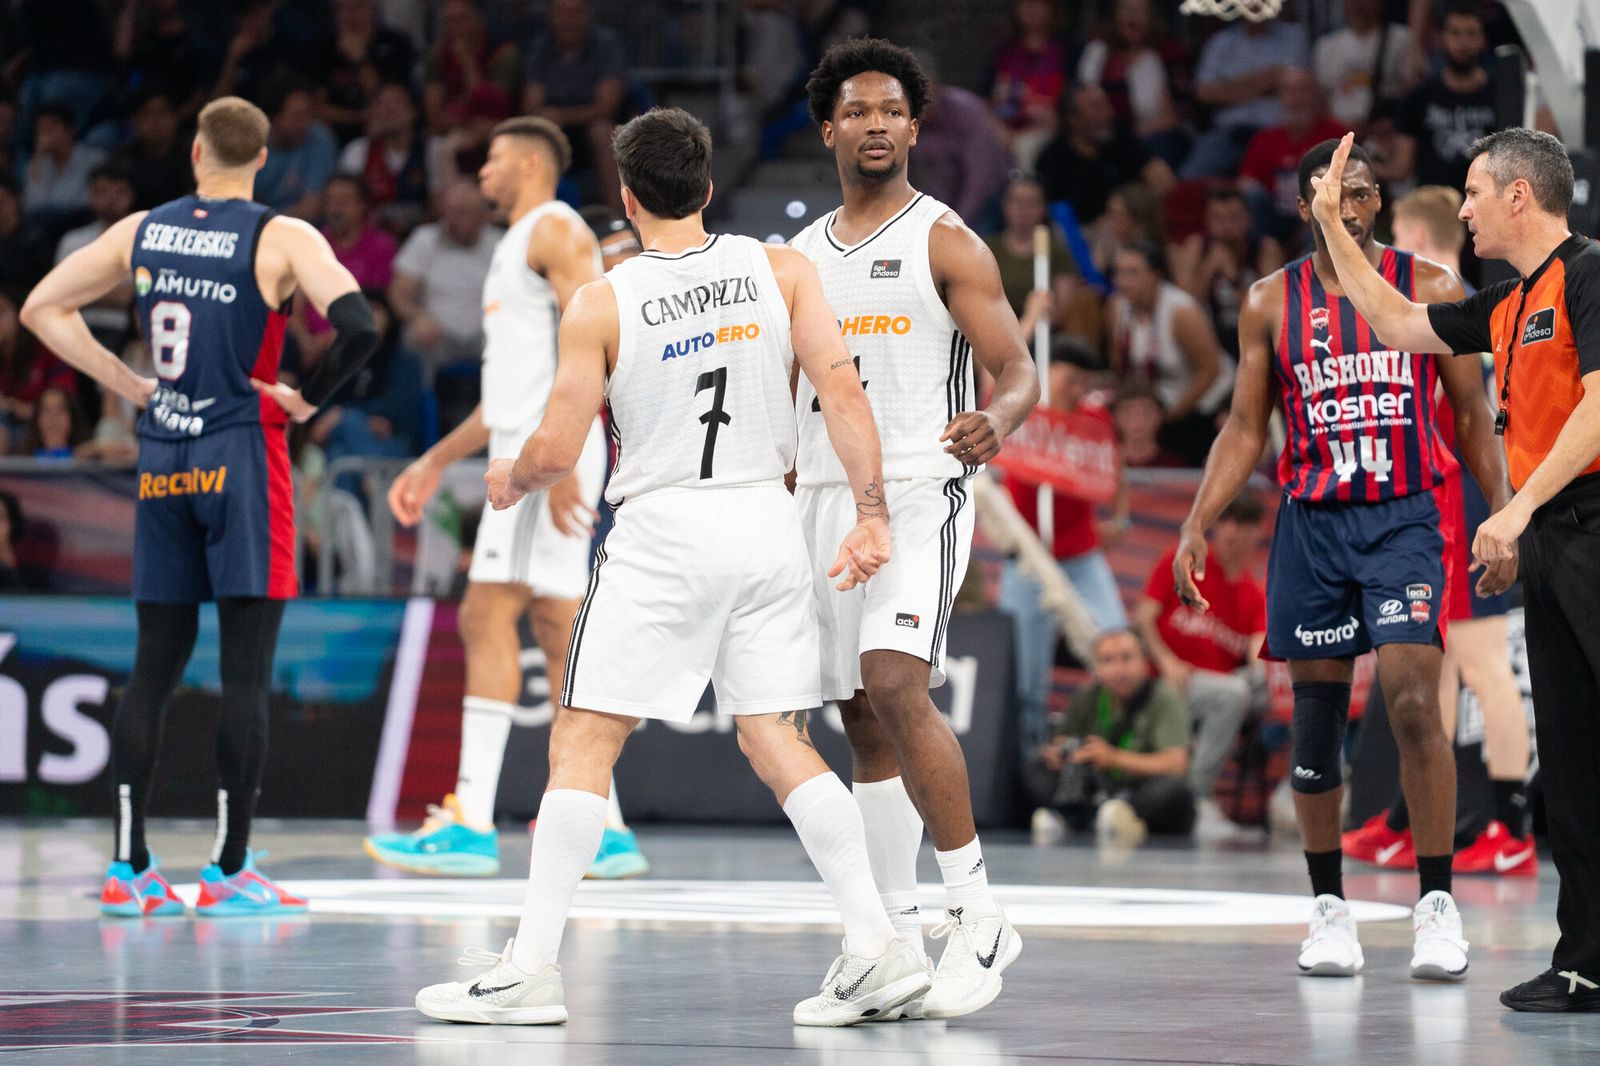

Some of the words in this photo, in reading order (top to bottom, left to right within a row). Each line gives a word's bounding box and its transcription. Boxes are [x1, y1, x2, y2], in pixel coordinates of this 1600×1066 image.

[141, 222, 239, 259] SEDEKERSKIS
[154, 273, 237, 304] AMUTIO
[641, 275, 758, 327] CAMPAZZO
[151, 301, 191, 381] 8
[838, 315, 912, 336] HERO
[1293, 351, 1414, 398] BASKONIA
[694, 366, 732, 480] 7
[1328, 435, 1393, 482] 44
[138, 465, 227, 501] Recalvi
[898, 618, 914, 626] acb
